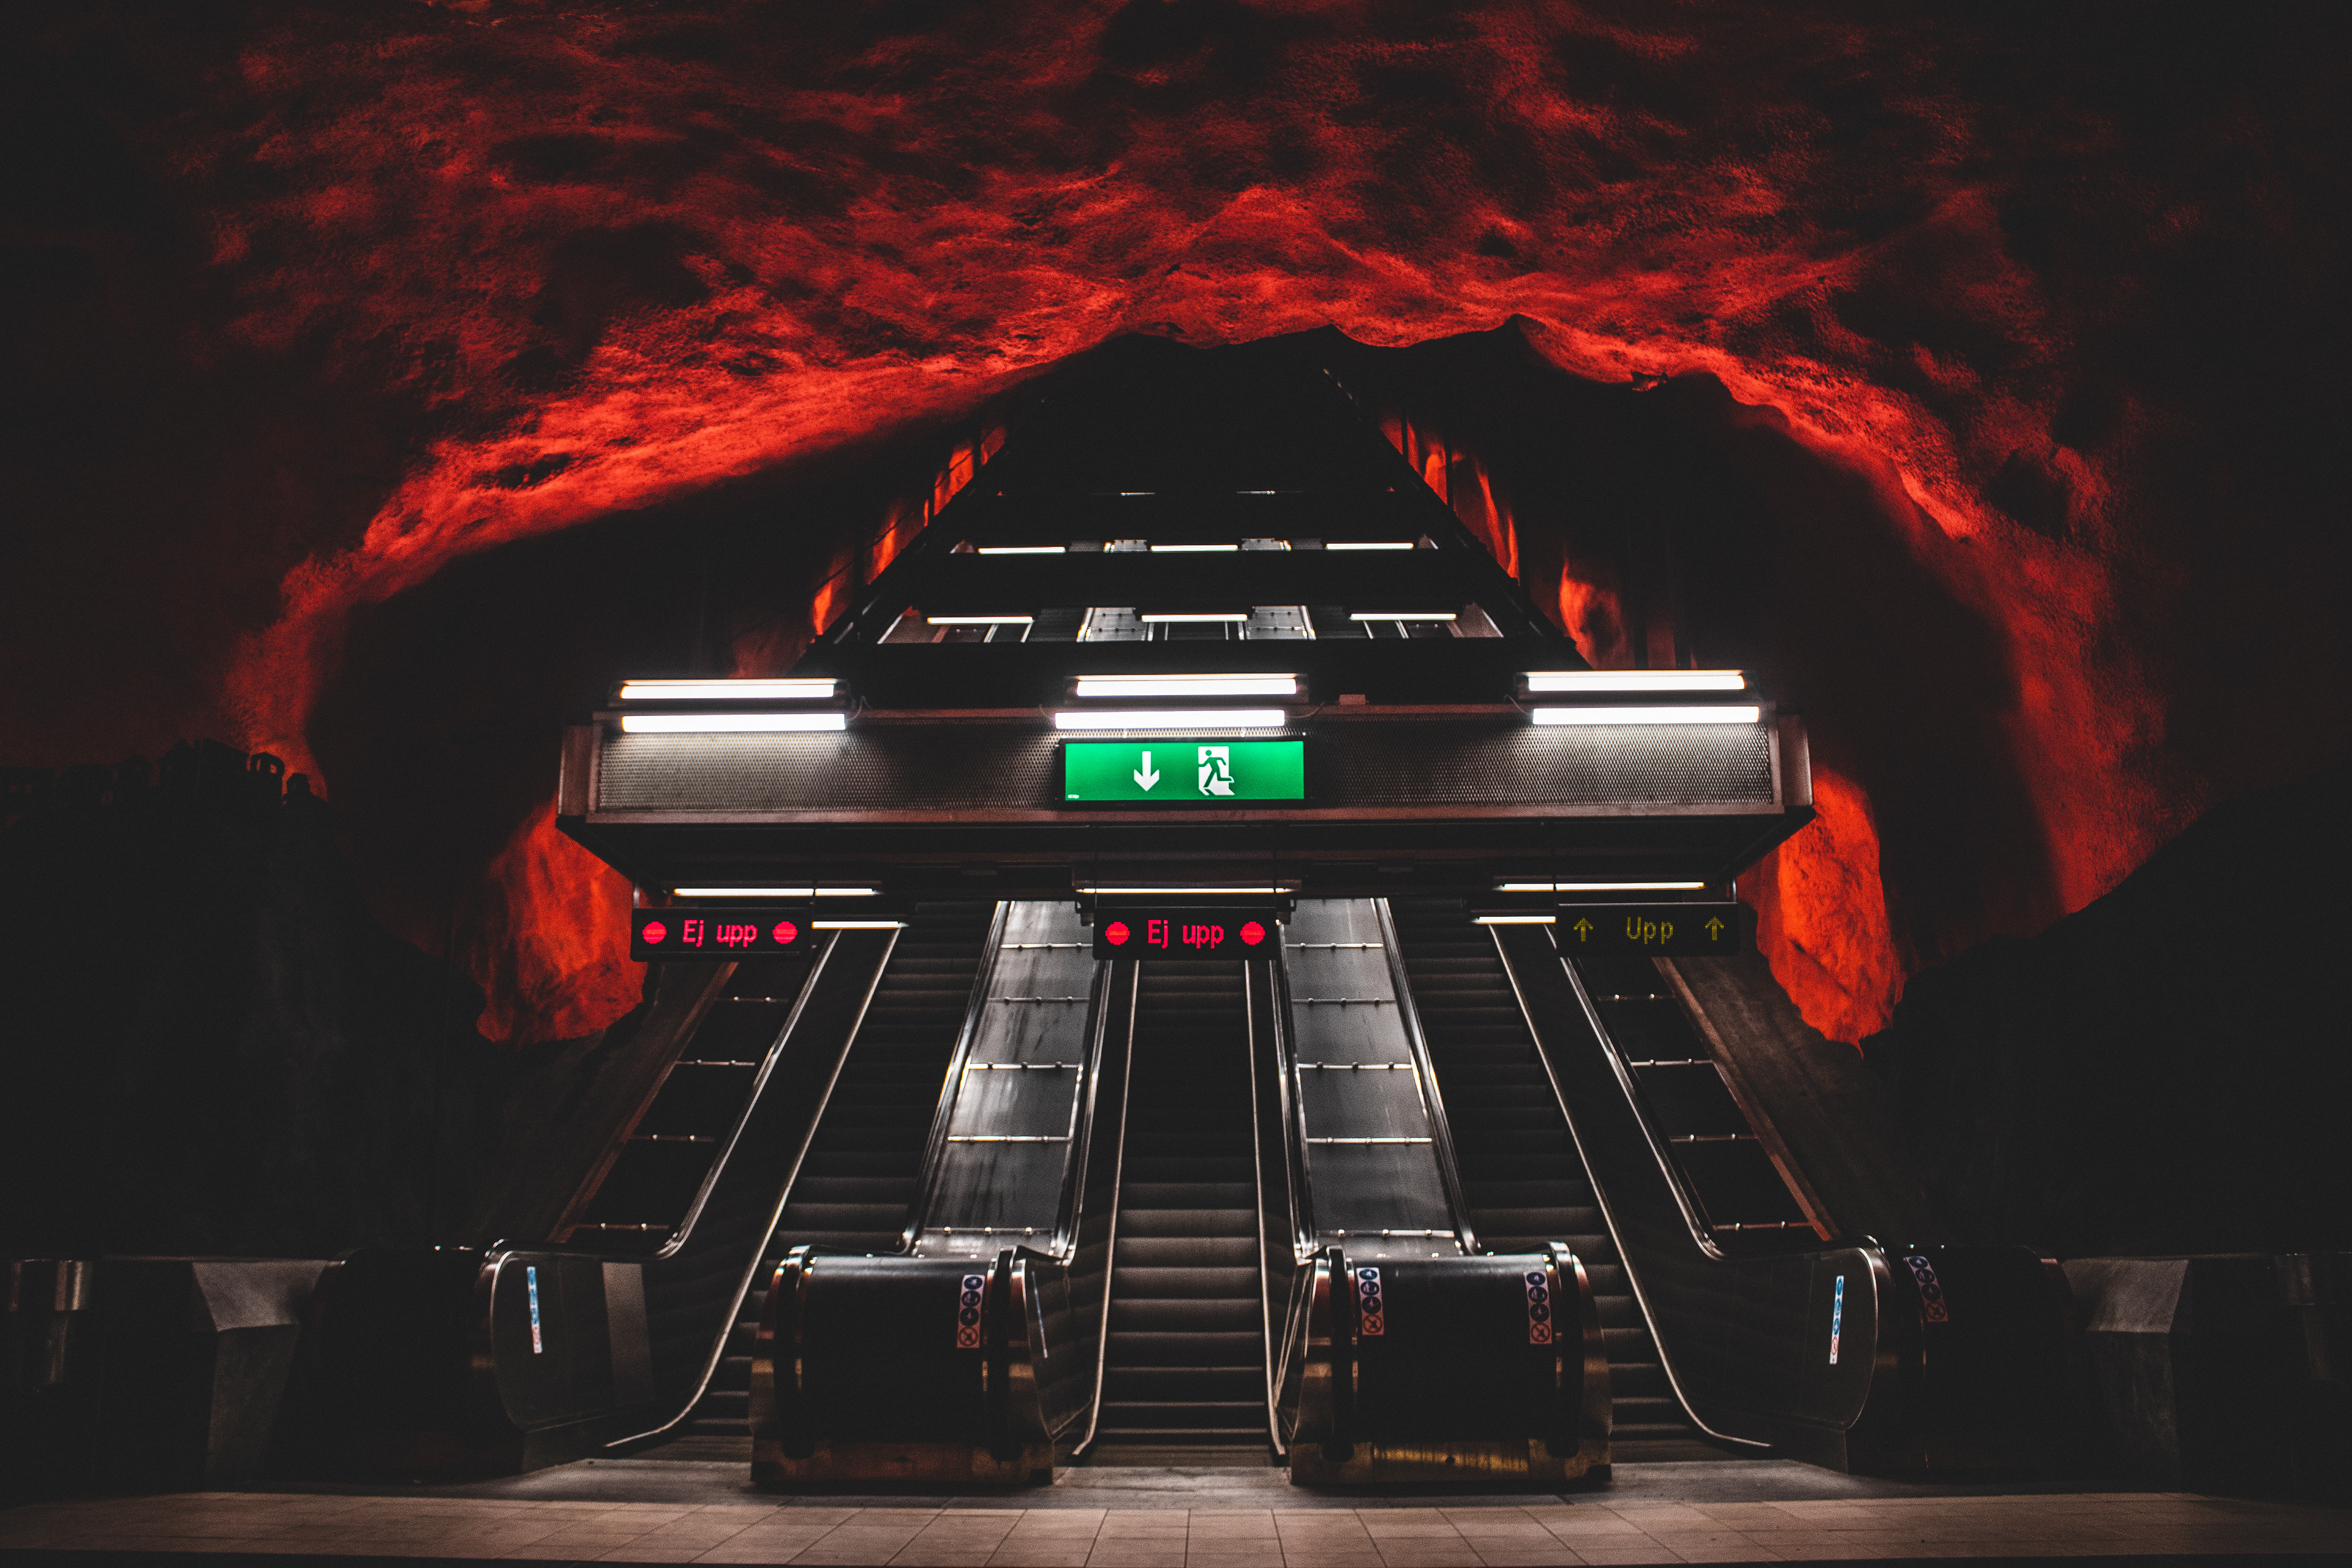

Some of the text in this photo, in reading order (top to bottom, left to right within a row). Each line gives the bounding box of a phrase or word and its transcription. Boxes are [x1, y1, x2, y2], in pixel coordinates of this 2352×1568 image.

[682, 919, 757, 948] Ej upp
[1148, 919, 1224, 949] Ej upp
[1626, 916, 1673, 944] Upp
